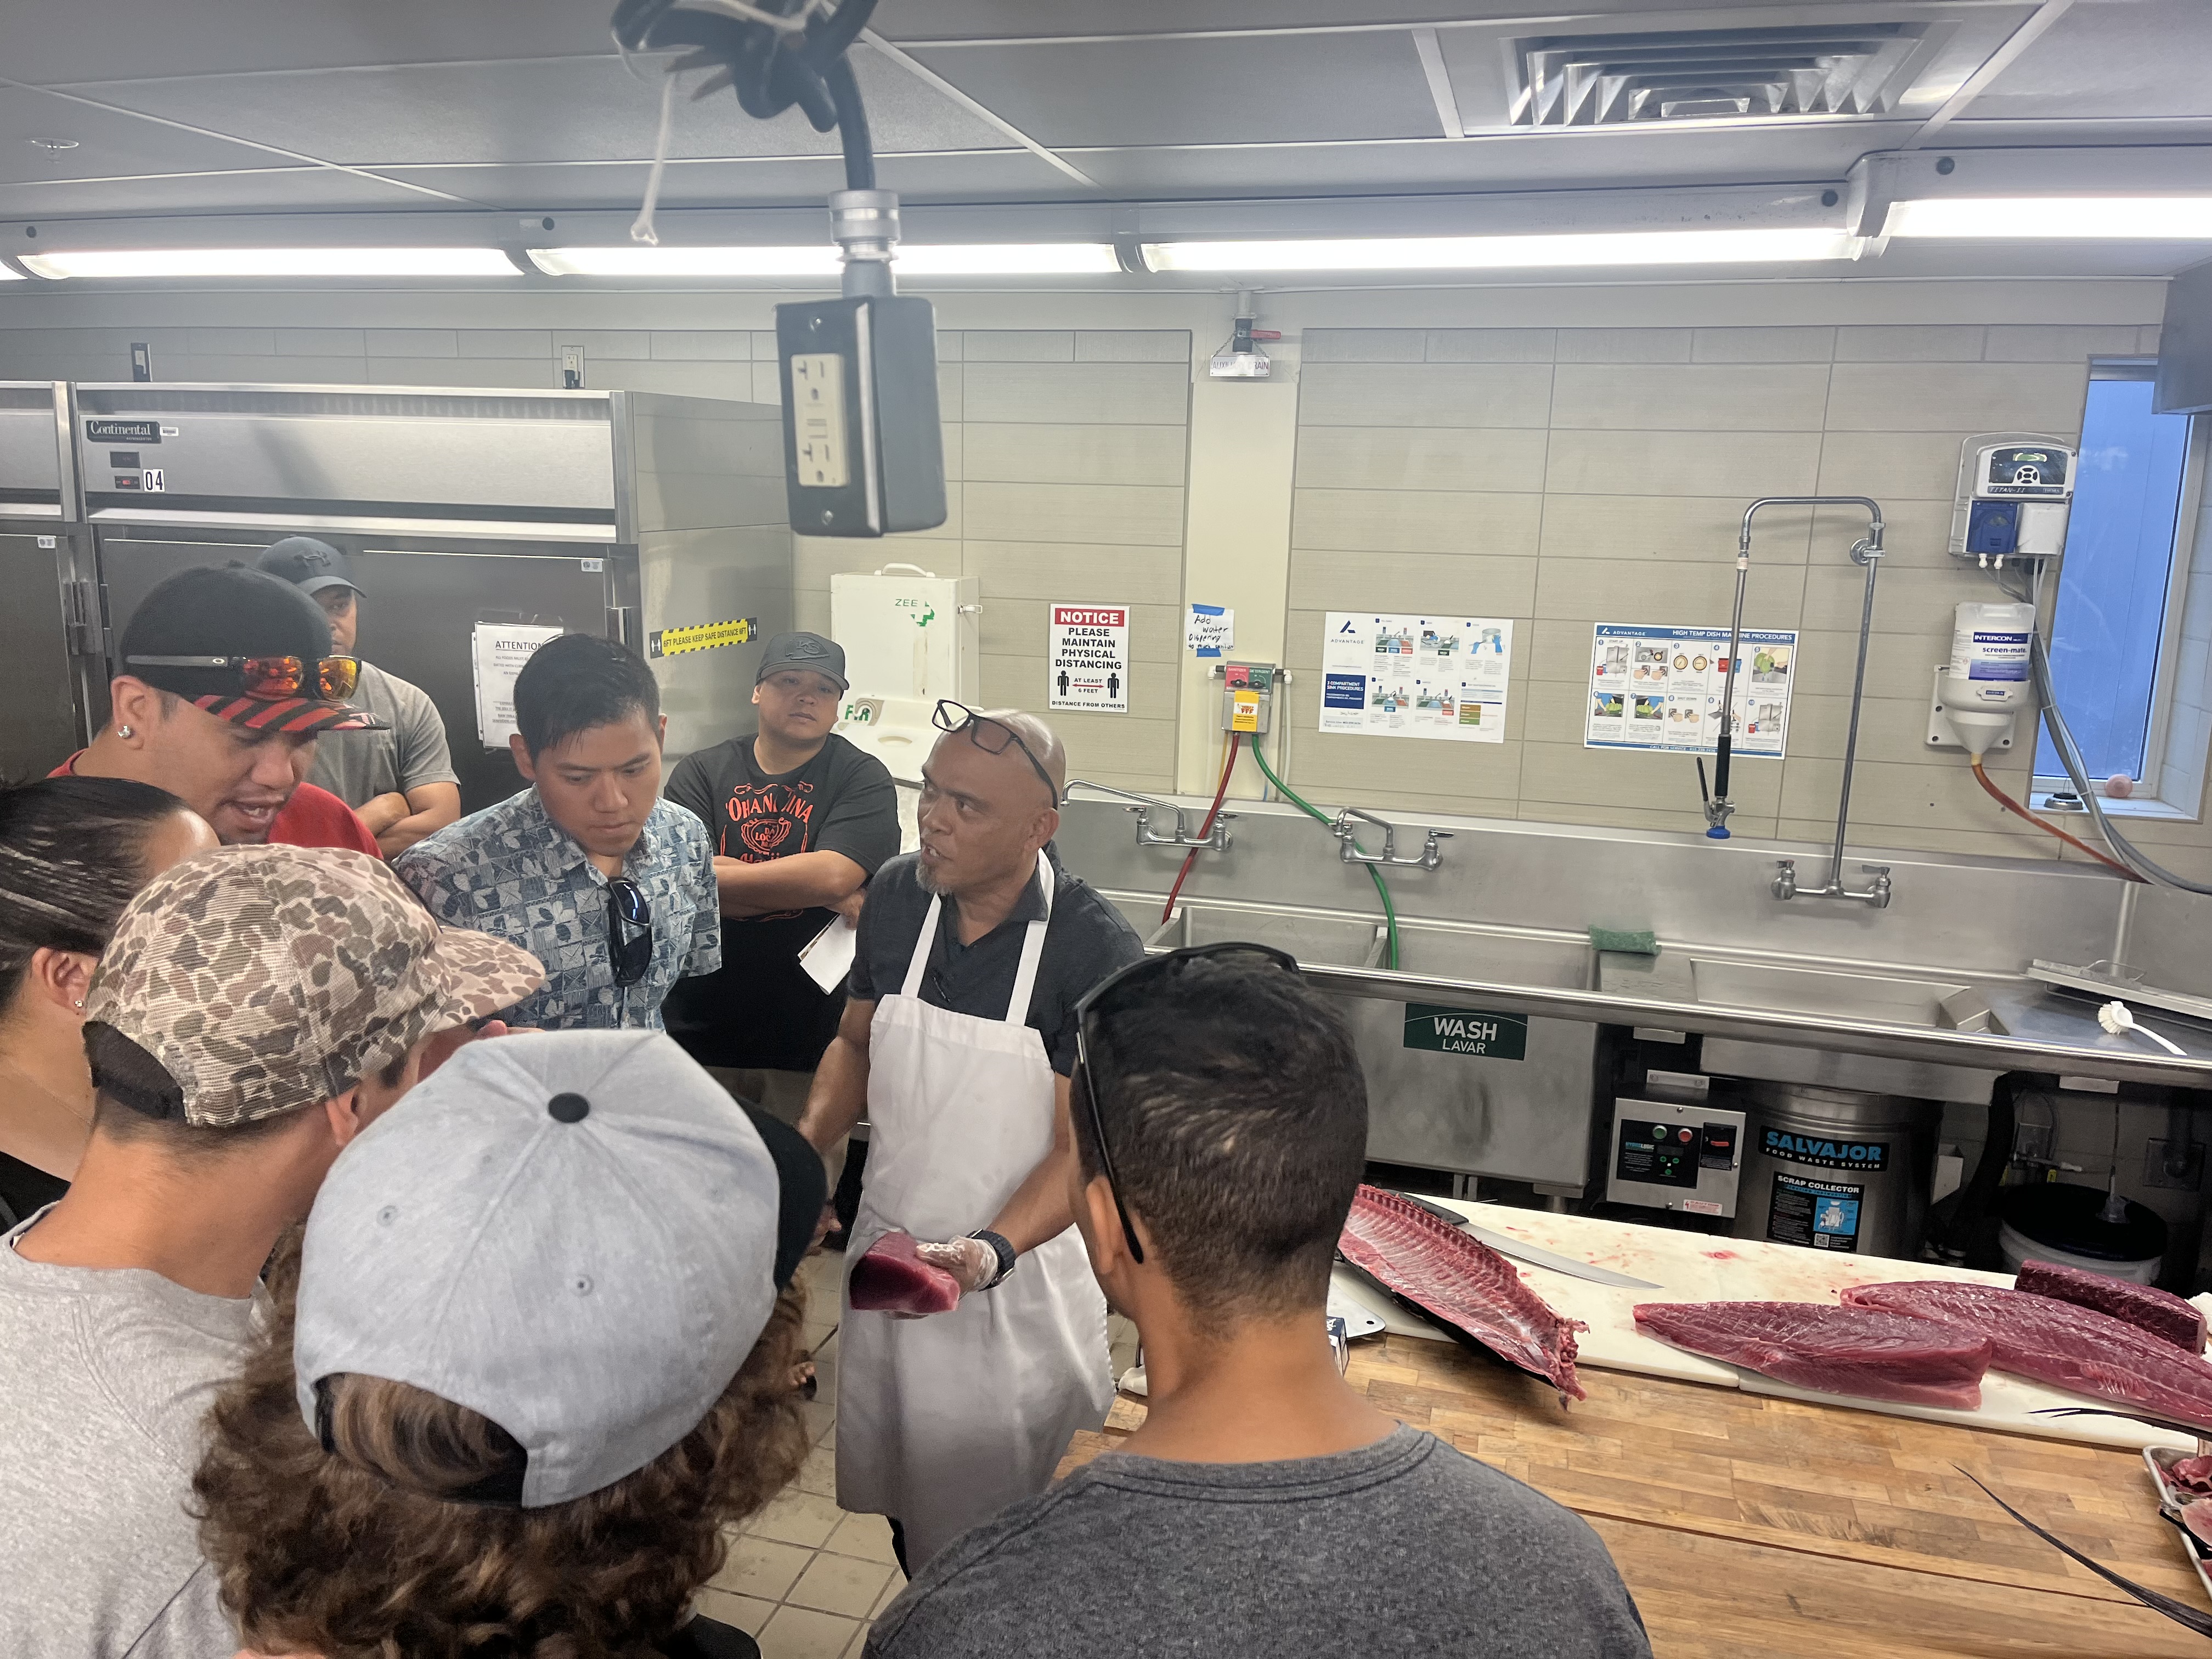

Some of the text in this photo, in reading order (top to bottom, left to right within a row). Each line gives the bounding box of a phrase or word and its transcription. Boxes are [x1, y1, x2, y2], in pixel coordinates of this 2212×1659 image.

[90, 421, 151, 436] Continental
[145, 471, 163, 491] 04
[895, 598, 918, 607] ZEE
[1060, 611, 1119, 624] NOTICE
[673, 636, 691, 646] PLEASE
[692, 634, 704, 642] KEEP
[705, 631, 716, 640] SAFE
[717, 628, 738, 639] DISTANCE
[1068, 627, 1110, 637] PLEASE
[1062, 638, 1115, 647] MAINTAIN
[1062, 648, 1116, 658] PHYSICAL
[1055, 659, 1122, 669] DISTANCING
[1434, 1017, 1497, 1041] WASH
[1442, 1039, 1486, 1054] LAVAR
[1766, 1131, 1882, 1161] SALVAJOR
[1766, 1147, 1792, 1158] FOOD
[1798, 1155, 1835, 1166] WASTE
[1778, 1175, 1859, 1193] SCRAP COLLECTOR
